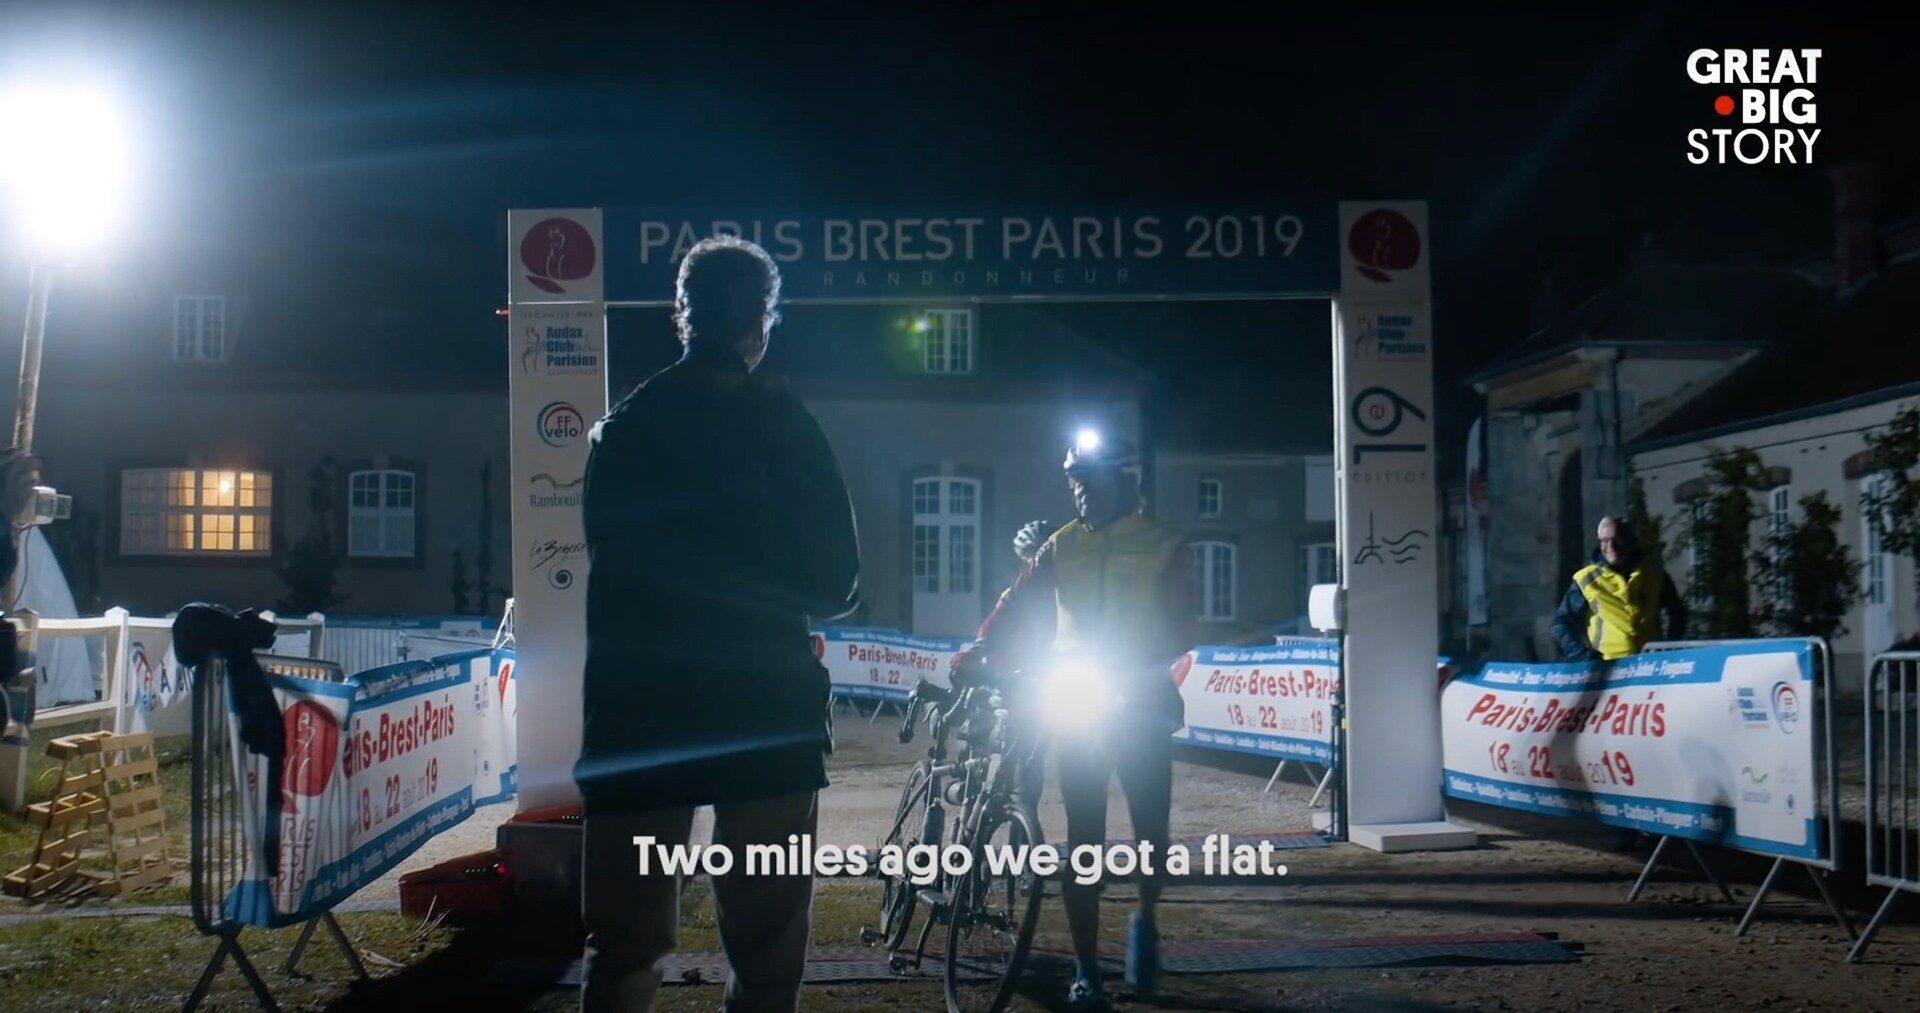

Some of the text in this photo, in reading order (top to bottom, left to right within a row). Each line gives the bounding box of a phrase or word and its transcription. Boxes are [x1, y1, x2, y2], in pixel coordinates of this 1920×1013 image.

[823, 218, 987, 262] BREST
[1003, 217, 1164, 260] PARIS
[1185, 214, 1304, 259] 2019
[824, 270, 1129, 287] RANDONNEUR
[343, 693, 455, 780] aris-Brest-Paris
[1227, 704, 1244, 726] 18
[1259, 706, 1277, 729] 22
[1489, 741, 1511, 774] 18
[1528, 745, 1555, 779] 22
[386, 774, 400, 819] 22
